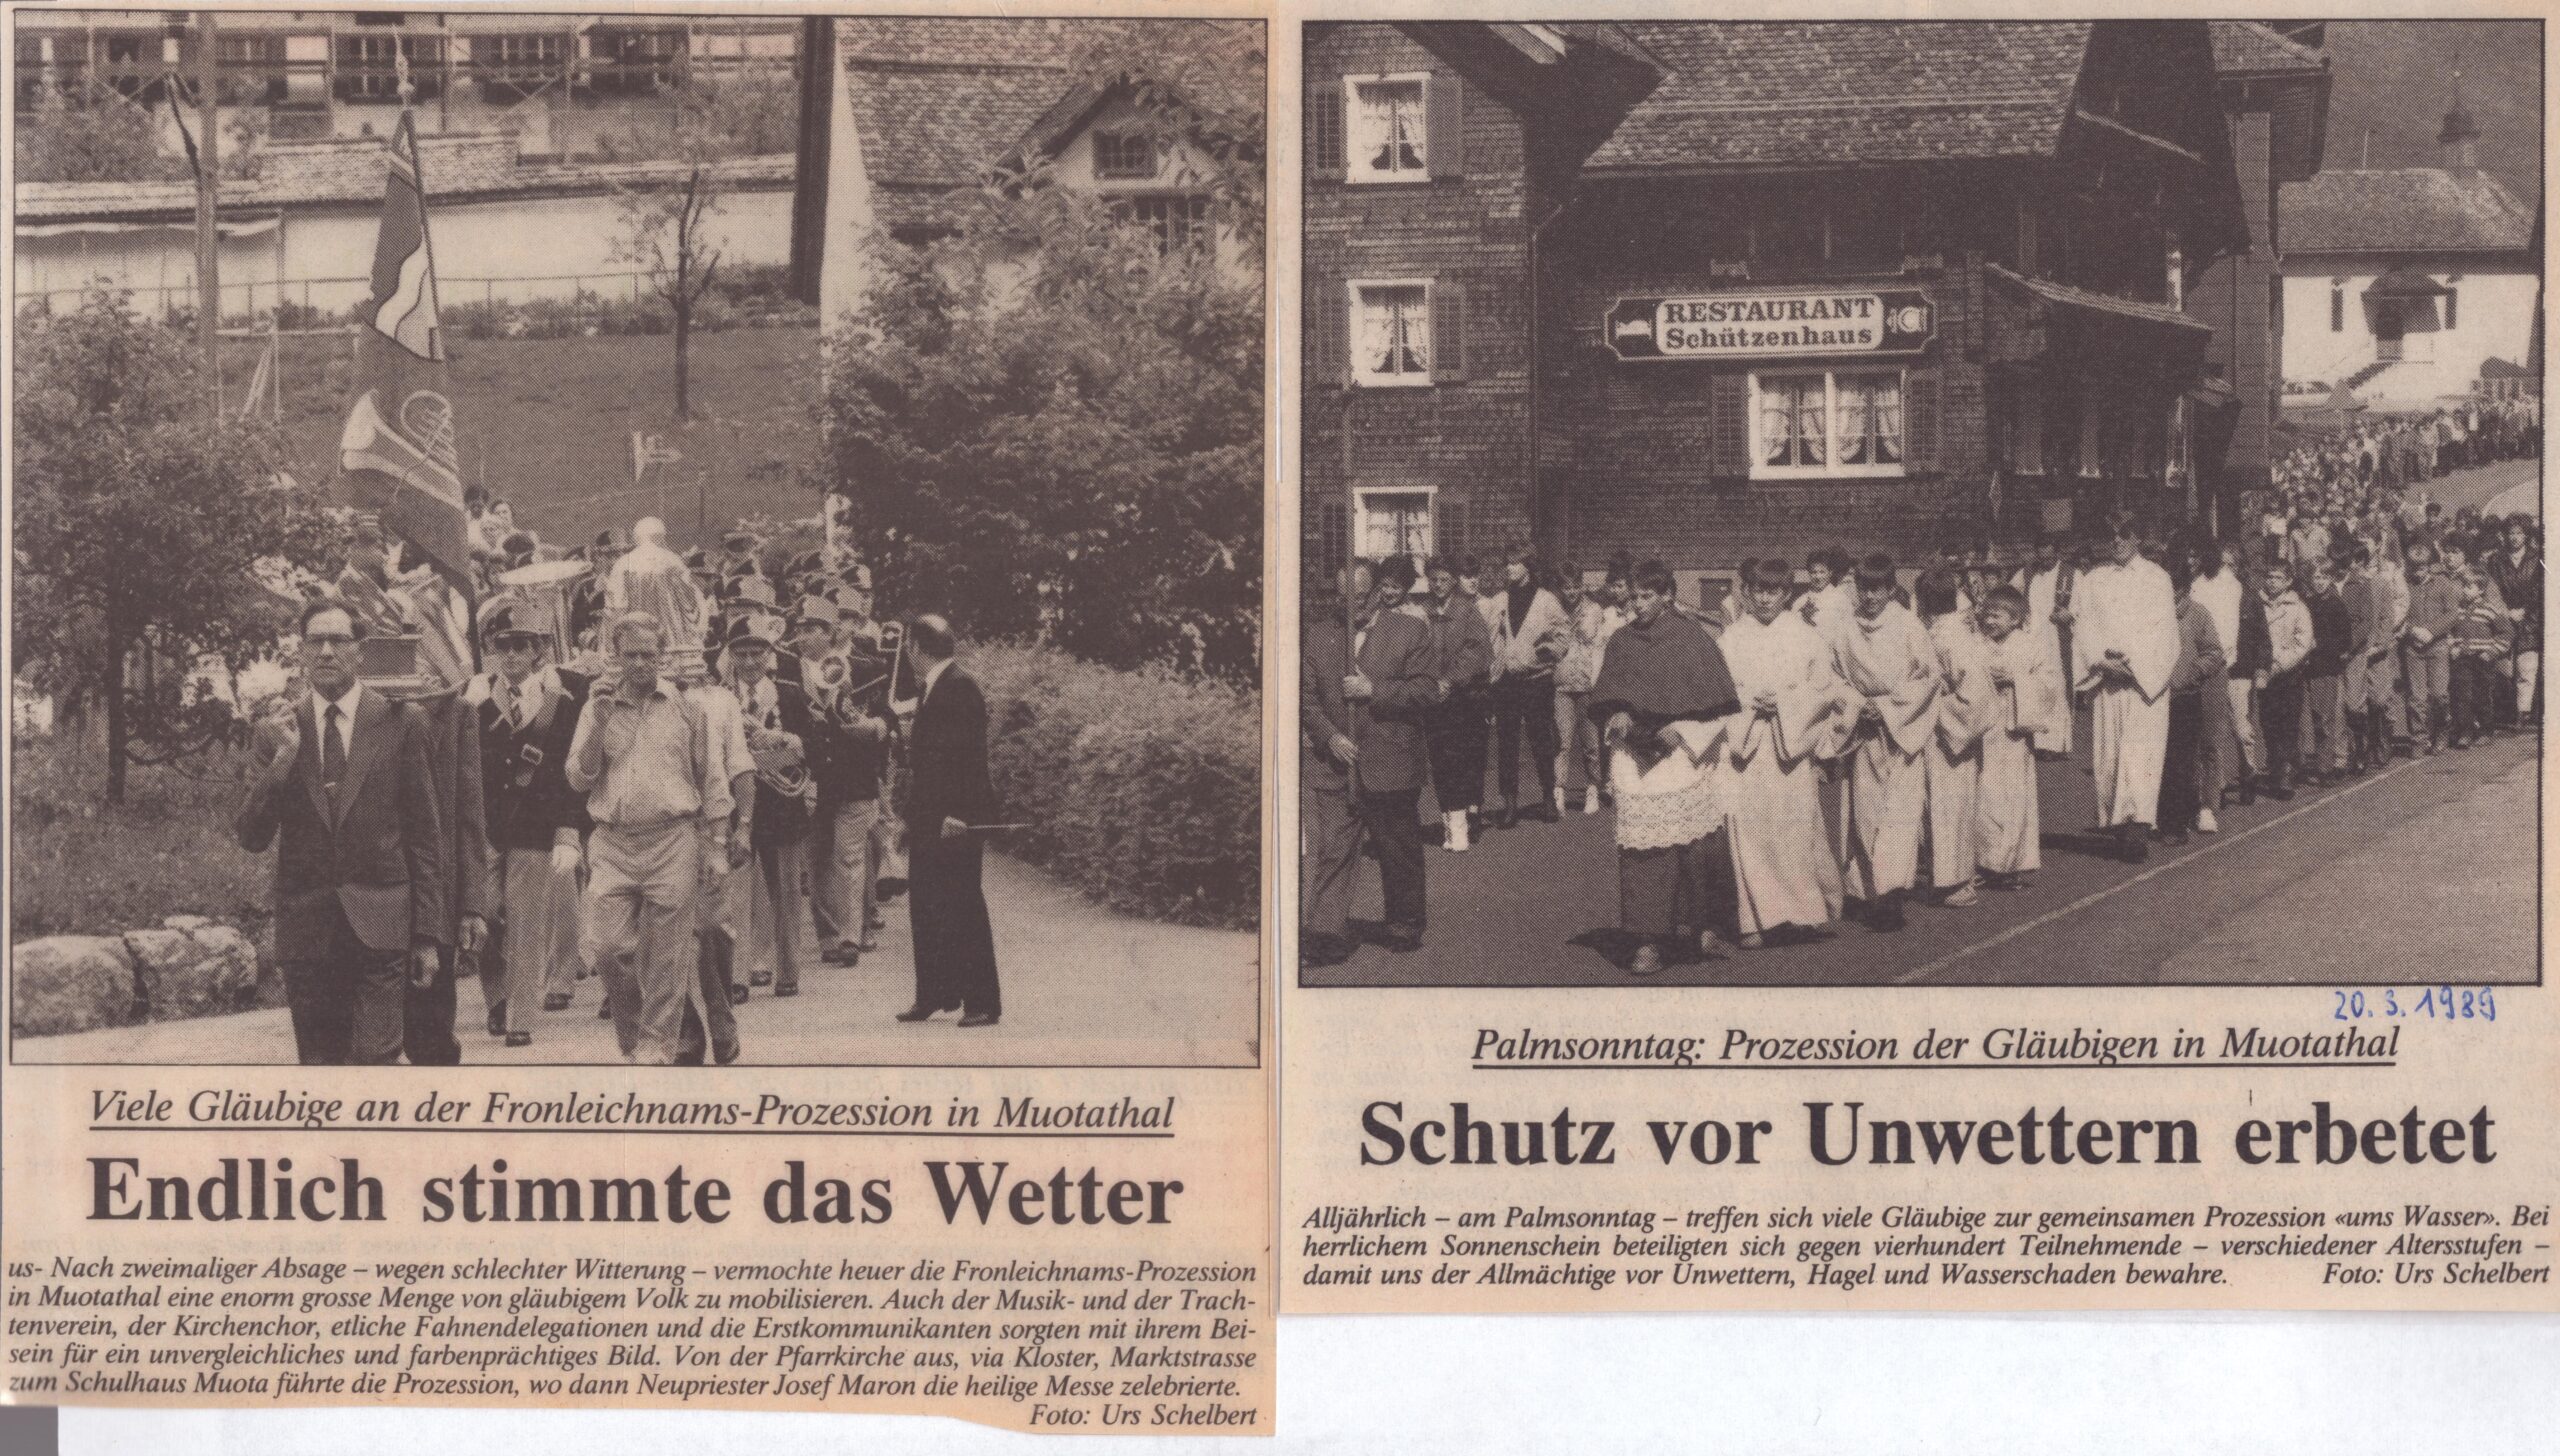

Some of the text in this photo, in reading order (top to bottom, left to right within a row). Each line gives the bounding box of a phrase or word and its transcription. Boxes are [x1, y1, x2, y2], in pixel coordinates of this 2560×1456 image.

[1664, 298, 1874, 323] RESTAURANT
[1666, 326, 1872, 349] Schützenhaus
[1472, 1026, 2400, 1064] Palmsonntag: Prozession der Gläubigen in Muotathal
[93, 1090, 1175, 1129] Viele Gläubige an der Fronleichnams-Prozession in Muotathal
[1361, 1102, 2497, 1165] Schutz vor Unwettern erbetet
[87, 1158, 1183, 1225] Endlich stimmte das Wetter
[1302, 1206, 1425, 1233] Alljährlich
[1458, 1213, 1495, 1227] am
[1504, 1206, 1656, 1233] Palmsonntag
[1687, 1206, 1758, 1233] treffen
[1768, 1206, 1812, 1227] sich
[1823, 1206, 1872, 1227] viele
[1882, 1206, 1986, 1233] Gläubige
[1994, 1213, 2032, 1227] zur
[2037, 1207, 2194, 1233] gemeinsamen
[2204, 1206, 2325, 1227] Prozession
[2336, 1212, 2393, 1226] «ums
[2405, 1205, 2499, 1226] Wasser».
[2512, 1205, 2549, 1226] Bei
[1303, 1235, 1426, 1256] herrlichem
[1441, 1235, 1599, 1256] Sonnenschein
[1614, 1234, 1727, 1261] beteiligten
[1740, 1235, 1784, 1256] sich
[1797, 1241, 1860, 1261] gegen
[1875, 1234, 2005, 1256] vierhundert
[2020, 1234, 2181, 1255] Teilnehmende
[2222, 1234, 2377, 1255] verschiedener
[2386, 1233, 2521, 1260] Altersstufen
[9, 1263, 42, 1277] us-
[51, 1257, 113, 1277] Nach
[121, 1257, 257, 1284] zweimaliger
[262, 1257, 346, 1284] Absage
[376, 1264, 444, 1284] wegen
[452, 1258, 567, 1279] schlechter
[576, 1259, 686, 1285] Witterung
[715, 1259, 832, 1280] vermochte
[840, 1259, 905, 1280] heuer
[911, 1260, 944, 1280] die
[953, 1260, 1255, 1281] Fronleichnams-Prozession
[1304, 1263, 2226, 1290] damit uns der Allmächtige vor Unwettern, Hagel und Wasserschaden bewahre.
[2323, 1262, 2549, 1283] Foto: Urs Schelbert
[9, 1286, 1255, 1313] in Muotathal eine enorm grosse Menge von gläubigem Volk zu mobilisieren. Auch der Musik- und der Trach-
[9, 1315, 1255, 1344] tenverein, der Kirchenchor, etliche Fahnendelegationen und die Erstkommunikanten sorgten mit ihrem Bei-
[11, 1342, 1256, 1372] sein für ein unvergleichliches und farbenprächtiges Bild. Von der Pfarrkirche aus, via Kloster, Marktstrasse
[11, 1371, 1239, 1401] zum Schulhaus Muota führte die Prozession, wo dann Neupriester Josef Maron die heilige Messe zelebrierte.
[1030, 1404, 1256, 1425] Foto: Urs Schelbert
